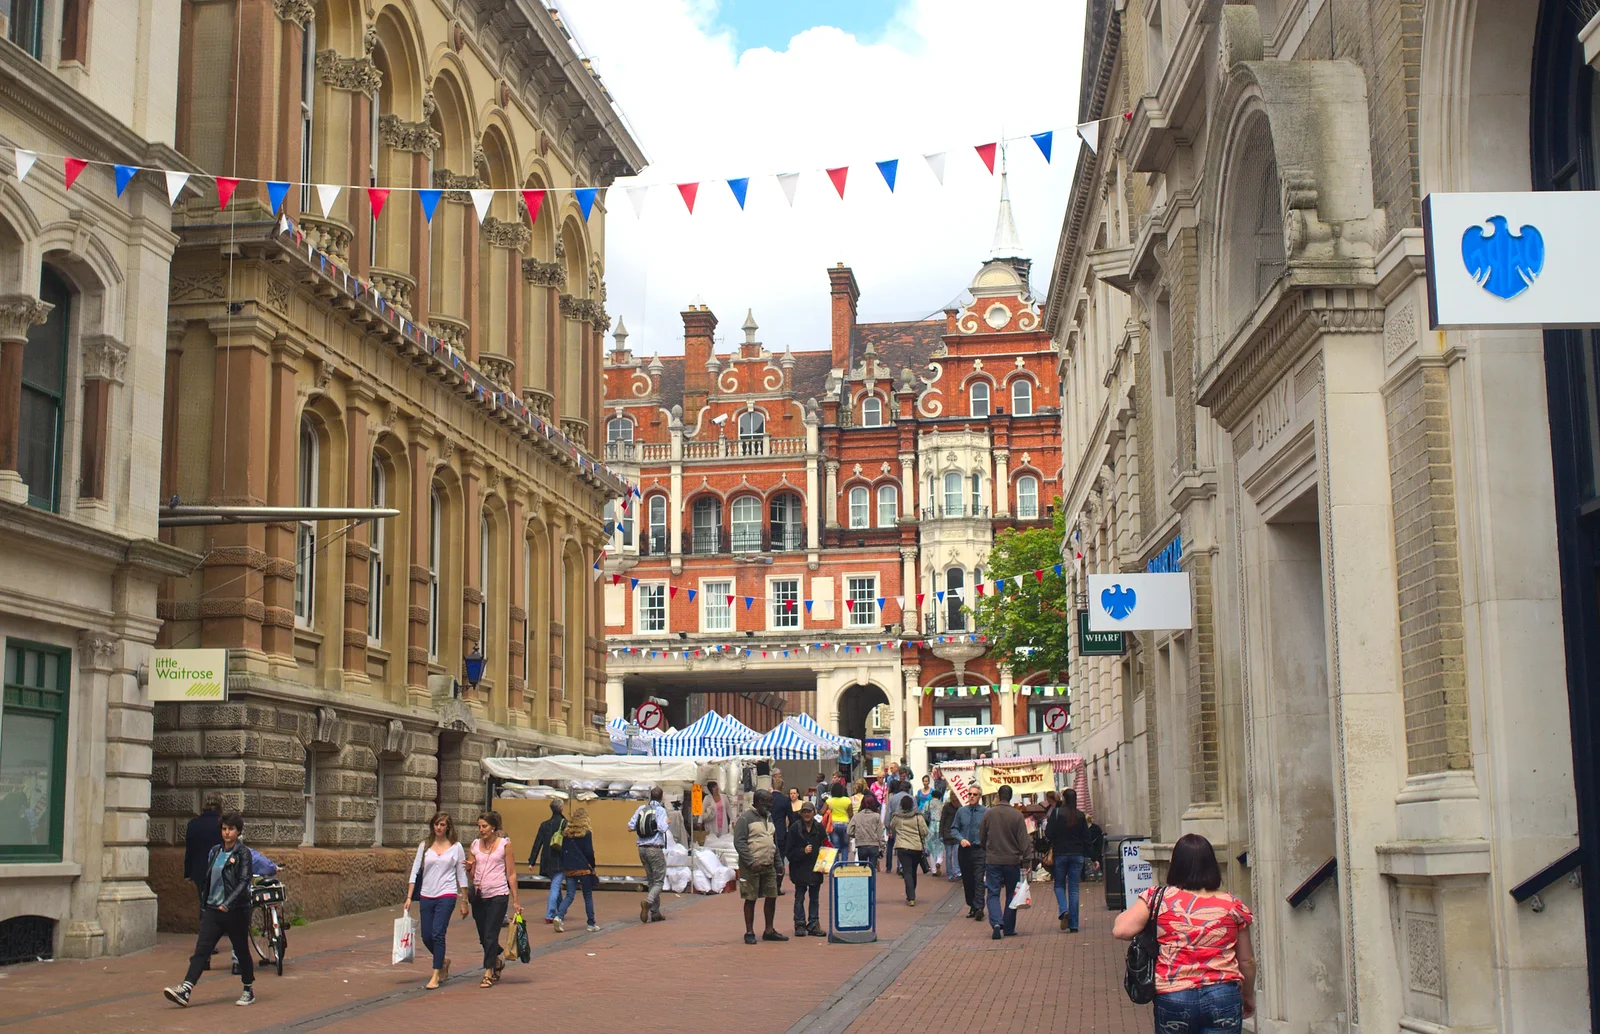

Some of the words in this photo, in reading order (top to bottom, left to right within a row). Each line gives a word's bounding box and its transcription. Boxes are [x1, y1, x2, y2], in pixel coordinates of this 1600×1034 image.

[1256, 379, 1290, 451] BANK
[1085, 634, 1120, 642] WHARF
[155, 657, 178, 668] little
[156, 667, 213, 679] Waitrose
[923, 728, 962, 736] SMIFFY'S
[965, 727, 994, 735] CHIPPY
[989, 776, 1002, 784] FOR
[1002, 775, 1021, 784] YOUR
[1021, 773, 1043, 783] EVENT
